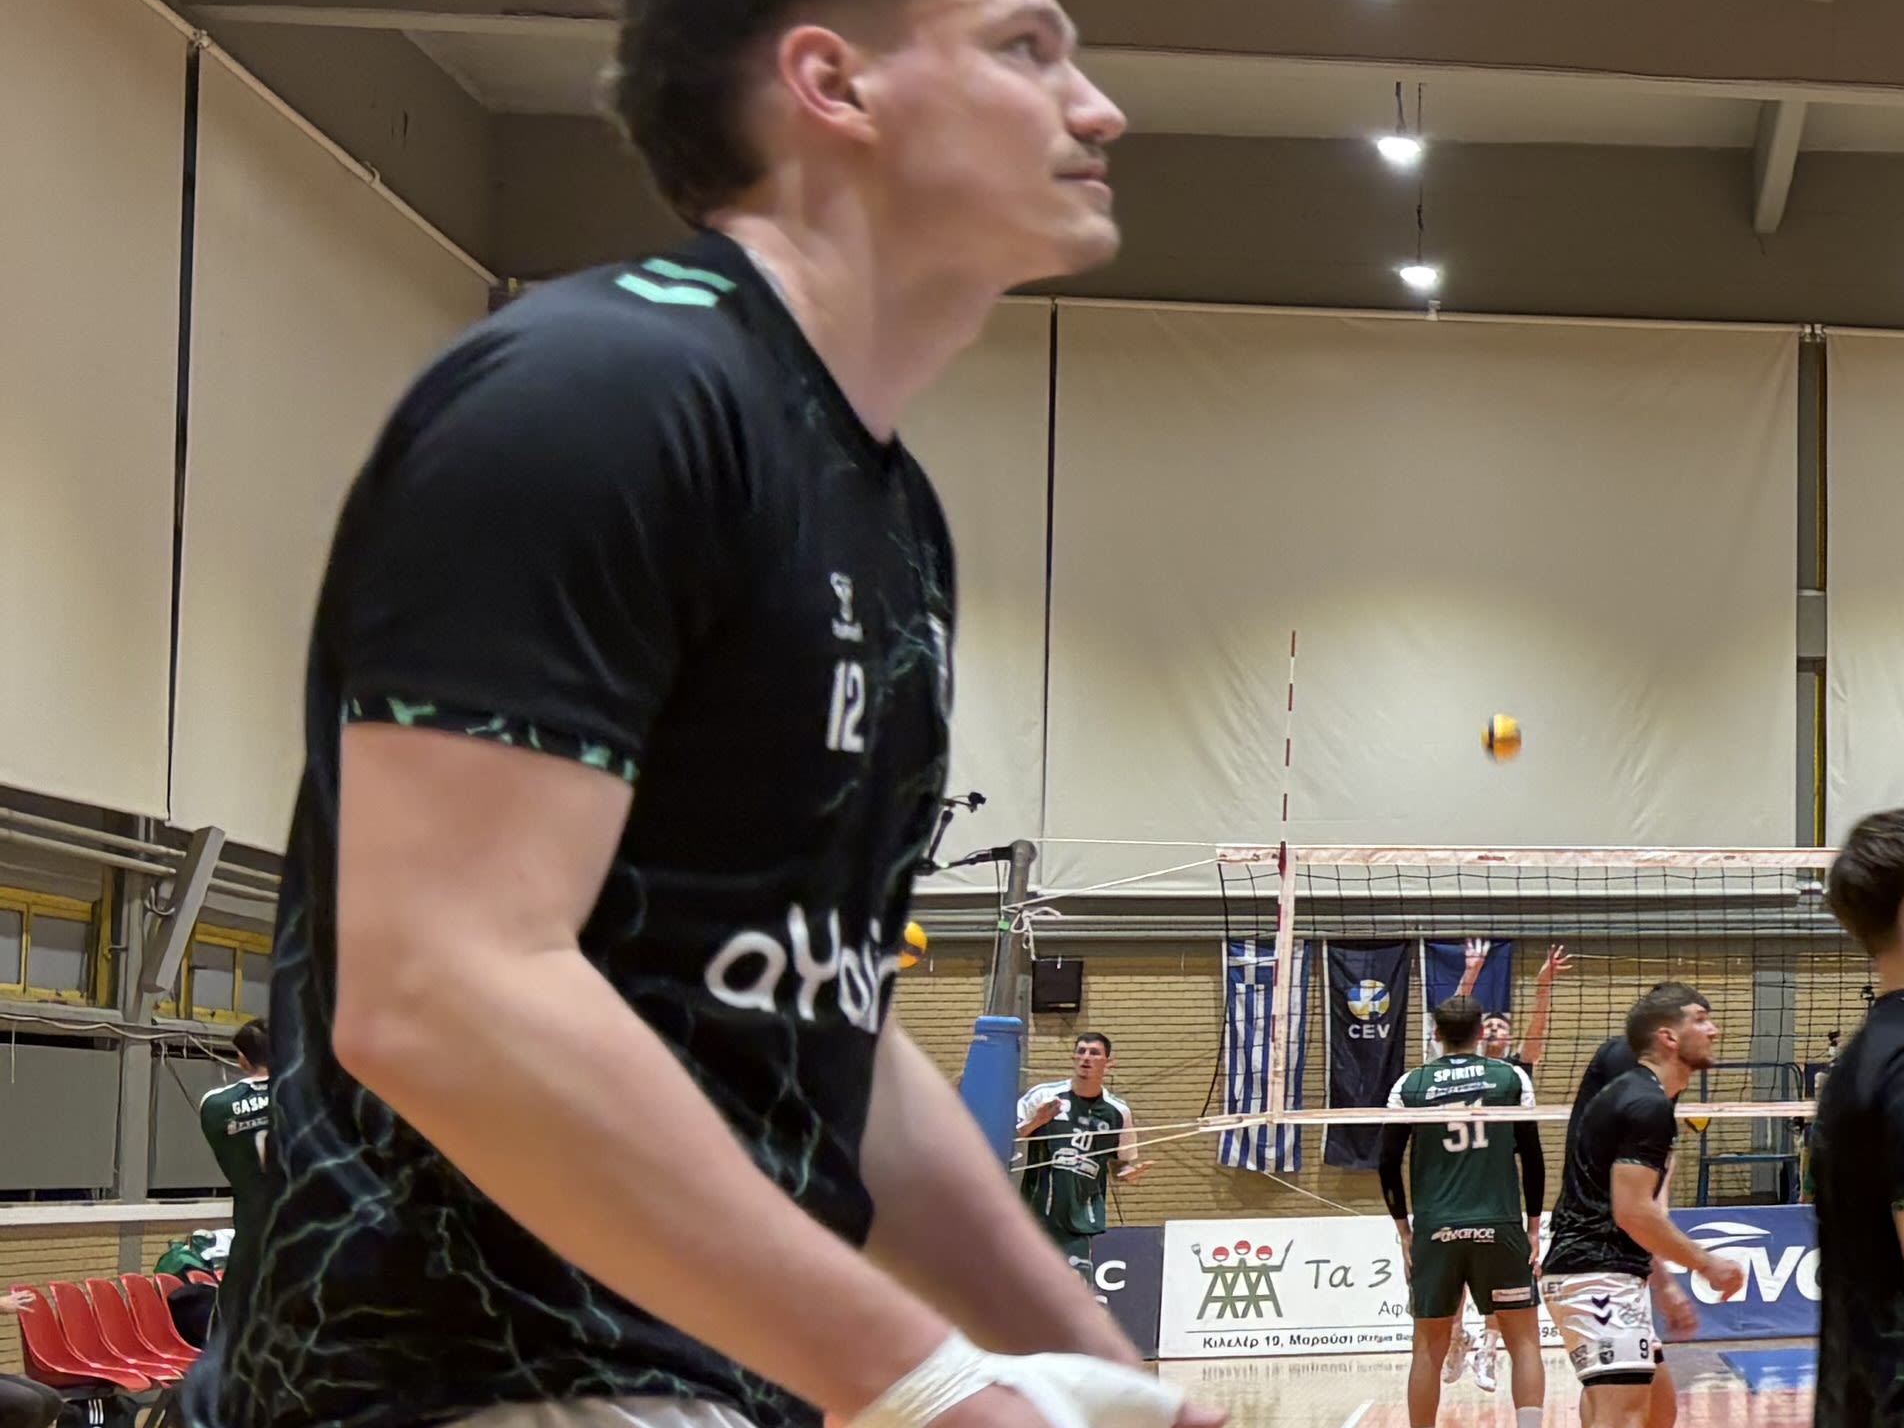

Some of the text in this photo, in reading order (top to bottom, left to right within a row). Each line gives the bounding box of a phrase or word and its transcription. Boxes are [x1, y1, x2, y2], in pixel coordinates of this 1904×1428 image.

[826, 661, 866, 753] 12
[1347, 1023, 1391, 1040] CEV
[1367, 1258, 1393, 1289] 3
